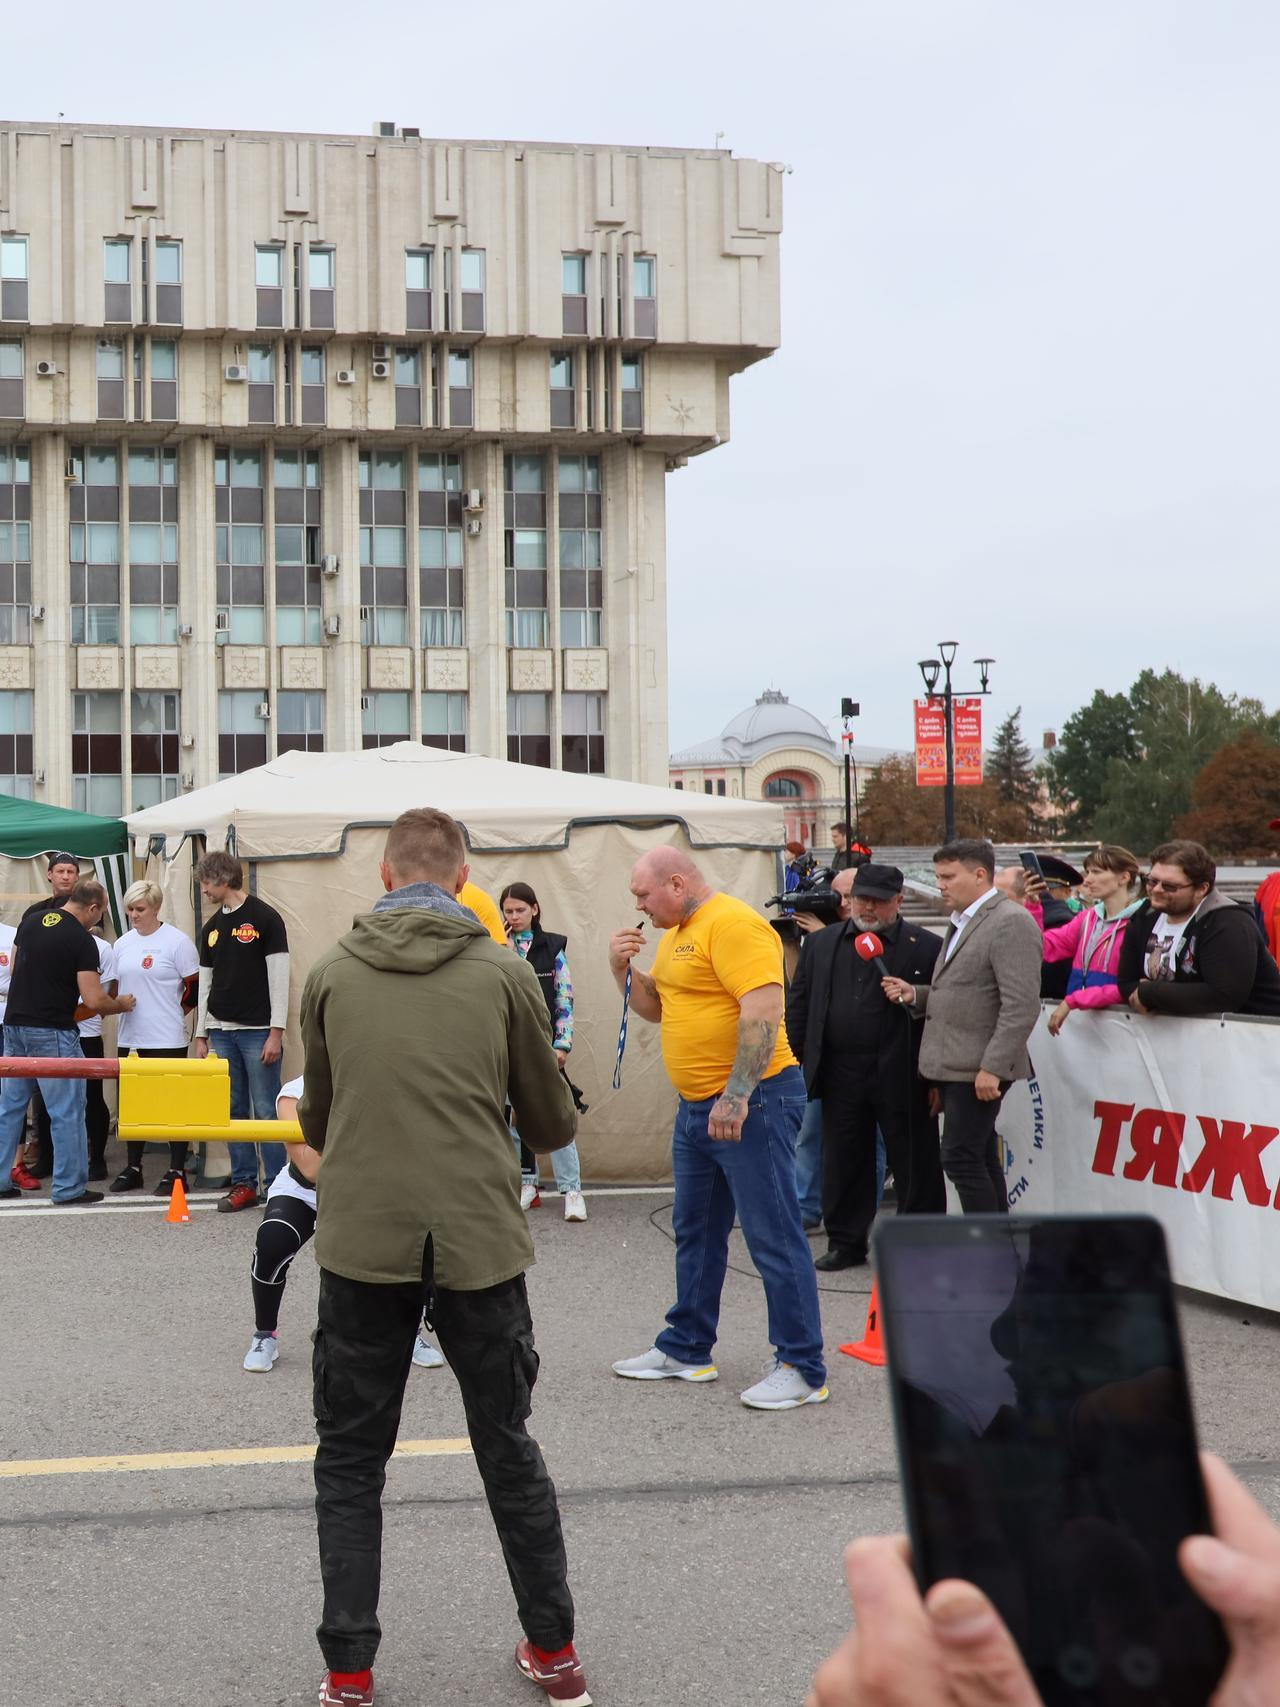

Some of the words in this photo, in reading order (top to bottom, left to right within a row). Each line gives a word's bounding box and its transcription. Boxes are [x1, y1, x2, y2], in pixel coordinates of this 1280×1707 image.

[1092, 1100, 1280, 1213] ТЯЖ
[1007, 1175, 1029, 1209] СТИ
[869, 1310, 876, 1332] 1
